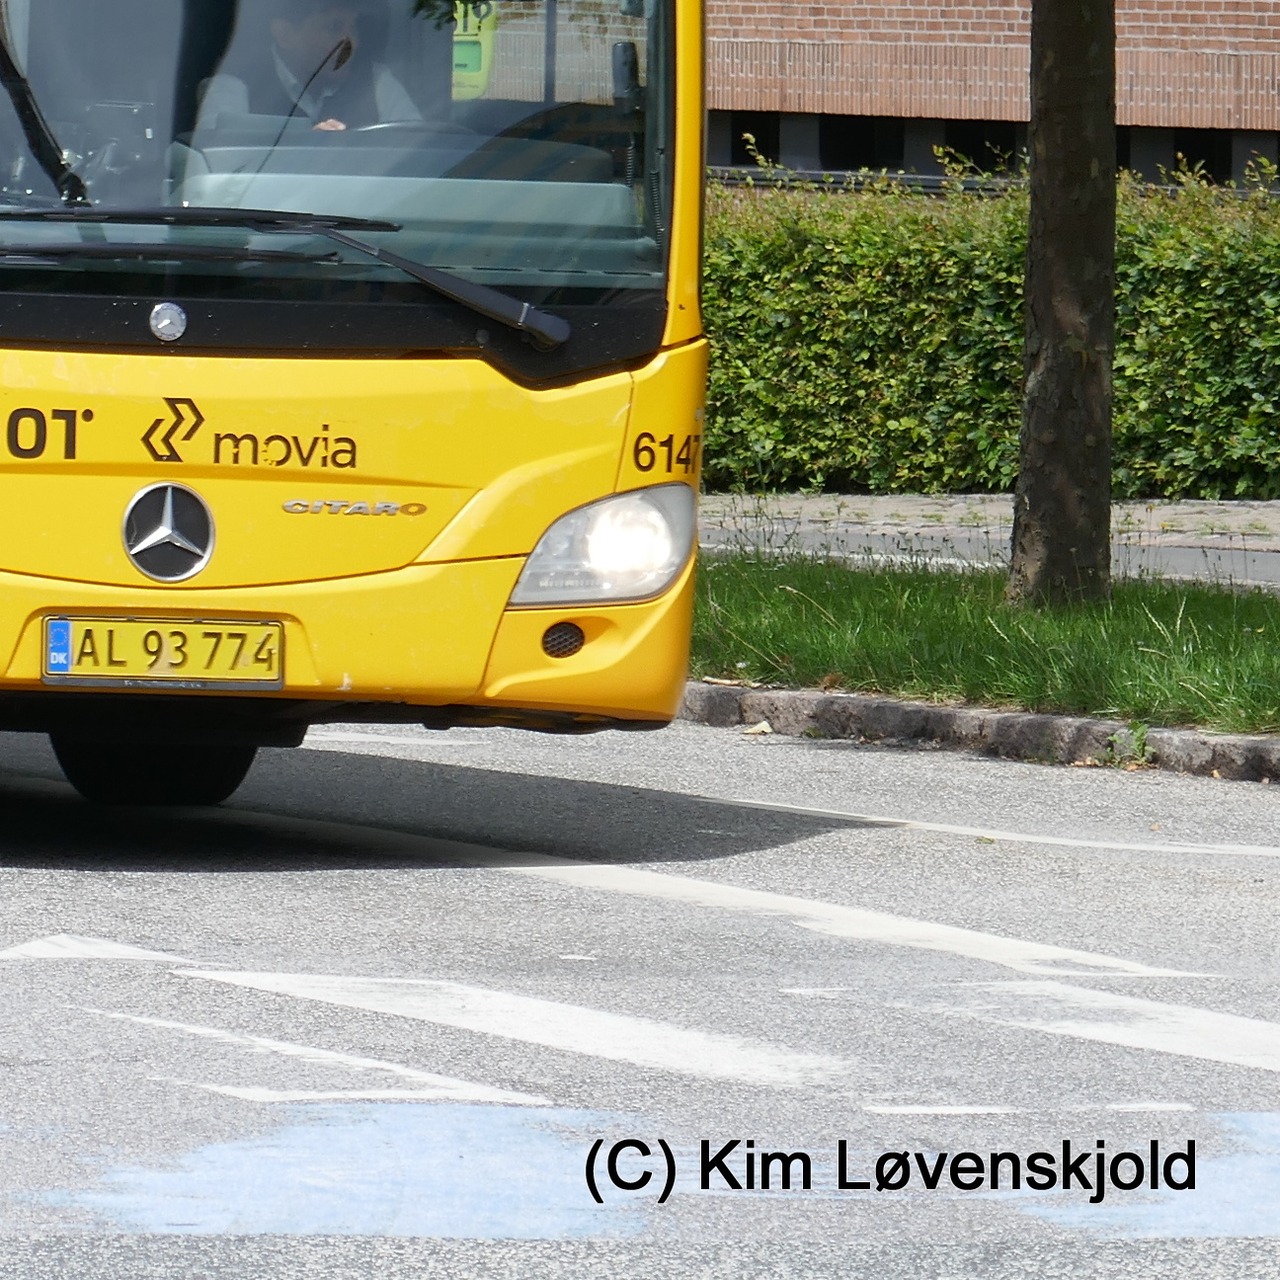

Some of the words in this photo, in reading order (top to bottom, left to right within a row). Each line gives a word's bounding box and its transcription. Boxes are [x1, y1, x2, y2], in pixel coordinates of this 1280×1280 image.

[213, 424, 358, 469] movia
[633, 431, 700, 474] 6147
[282, 499, 428, 517] CITARO
[50, 651, 68, 665] DK
[76, 628, 128, 668] AL
[142, 629, 188, 671] 93
[201, 631, 277, 672] 774
